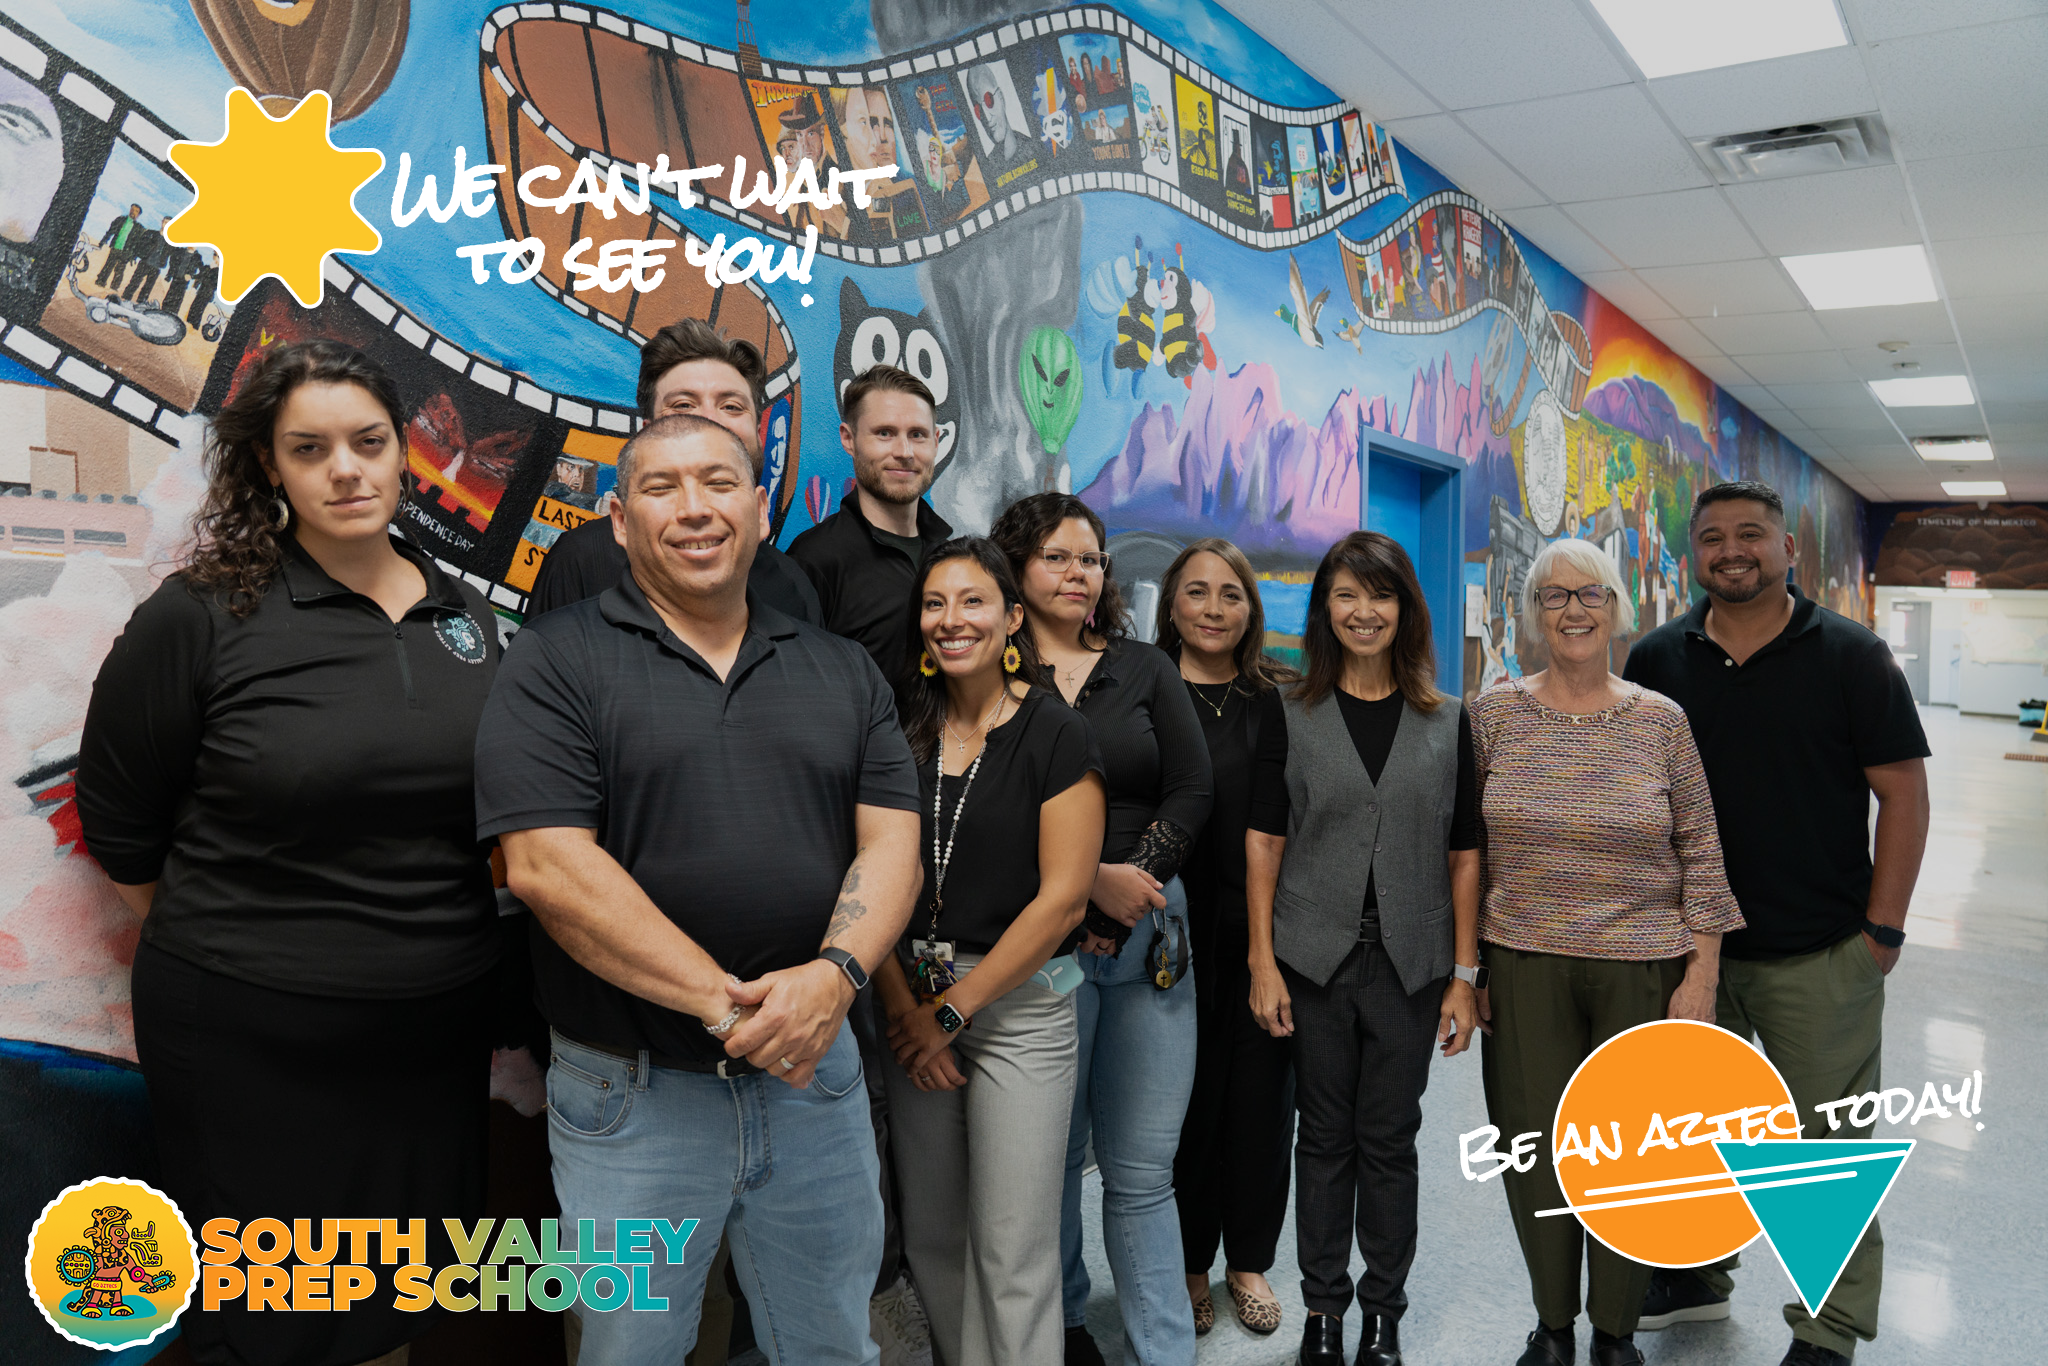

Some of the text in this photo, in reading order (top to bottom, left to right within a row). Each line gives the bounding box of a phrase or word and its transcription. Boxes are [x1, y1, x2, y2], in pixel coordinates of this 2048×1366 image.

[935, 100, 957, 112] GIRL
[1916, 517, 2037, 527] TIMELINE OF NEW MEXICO
[454, 534, 475, 552] DAY
